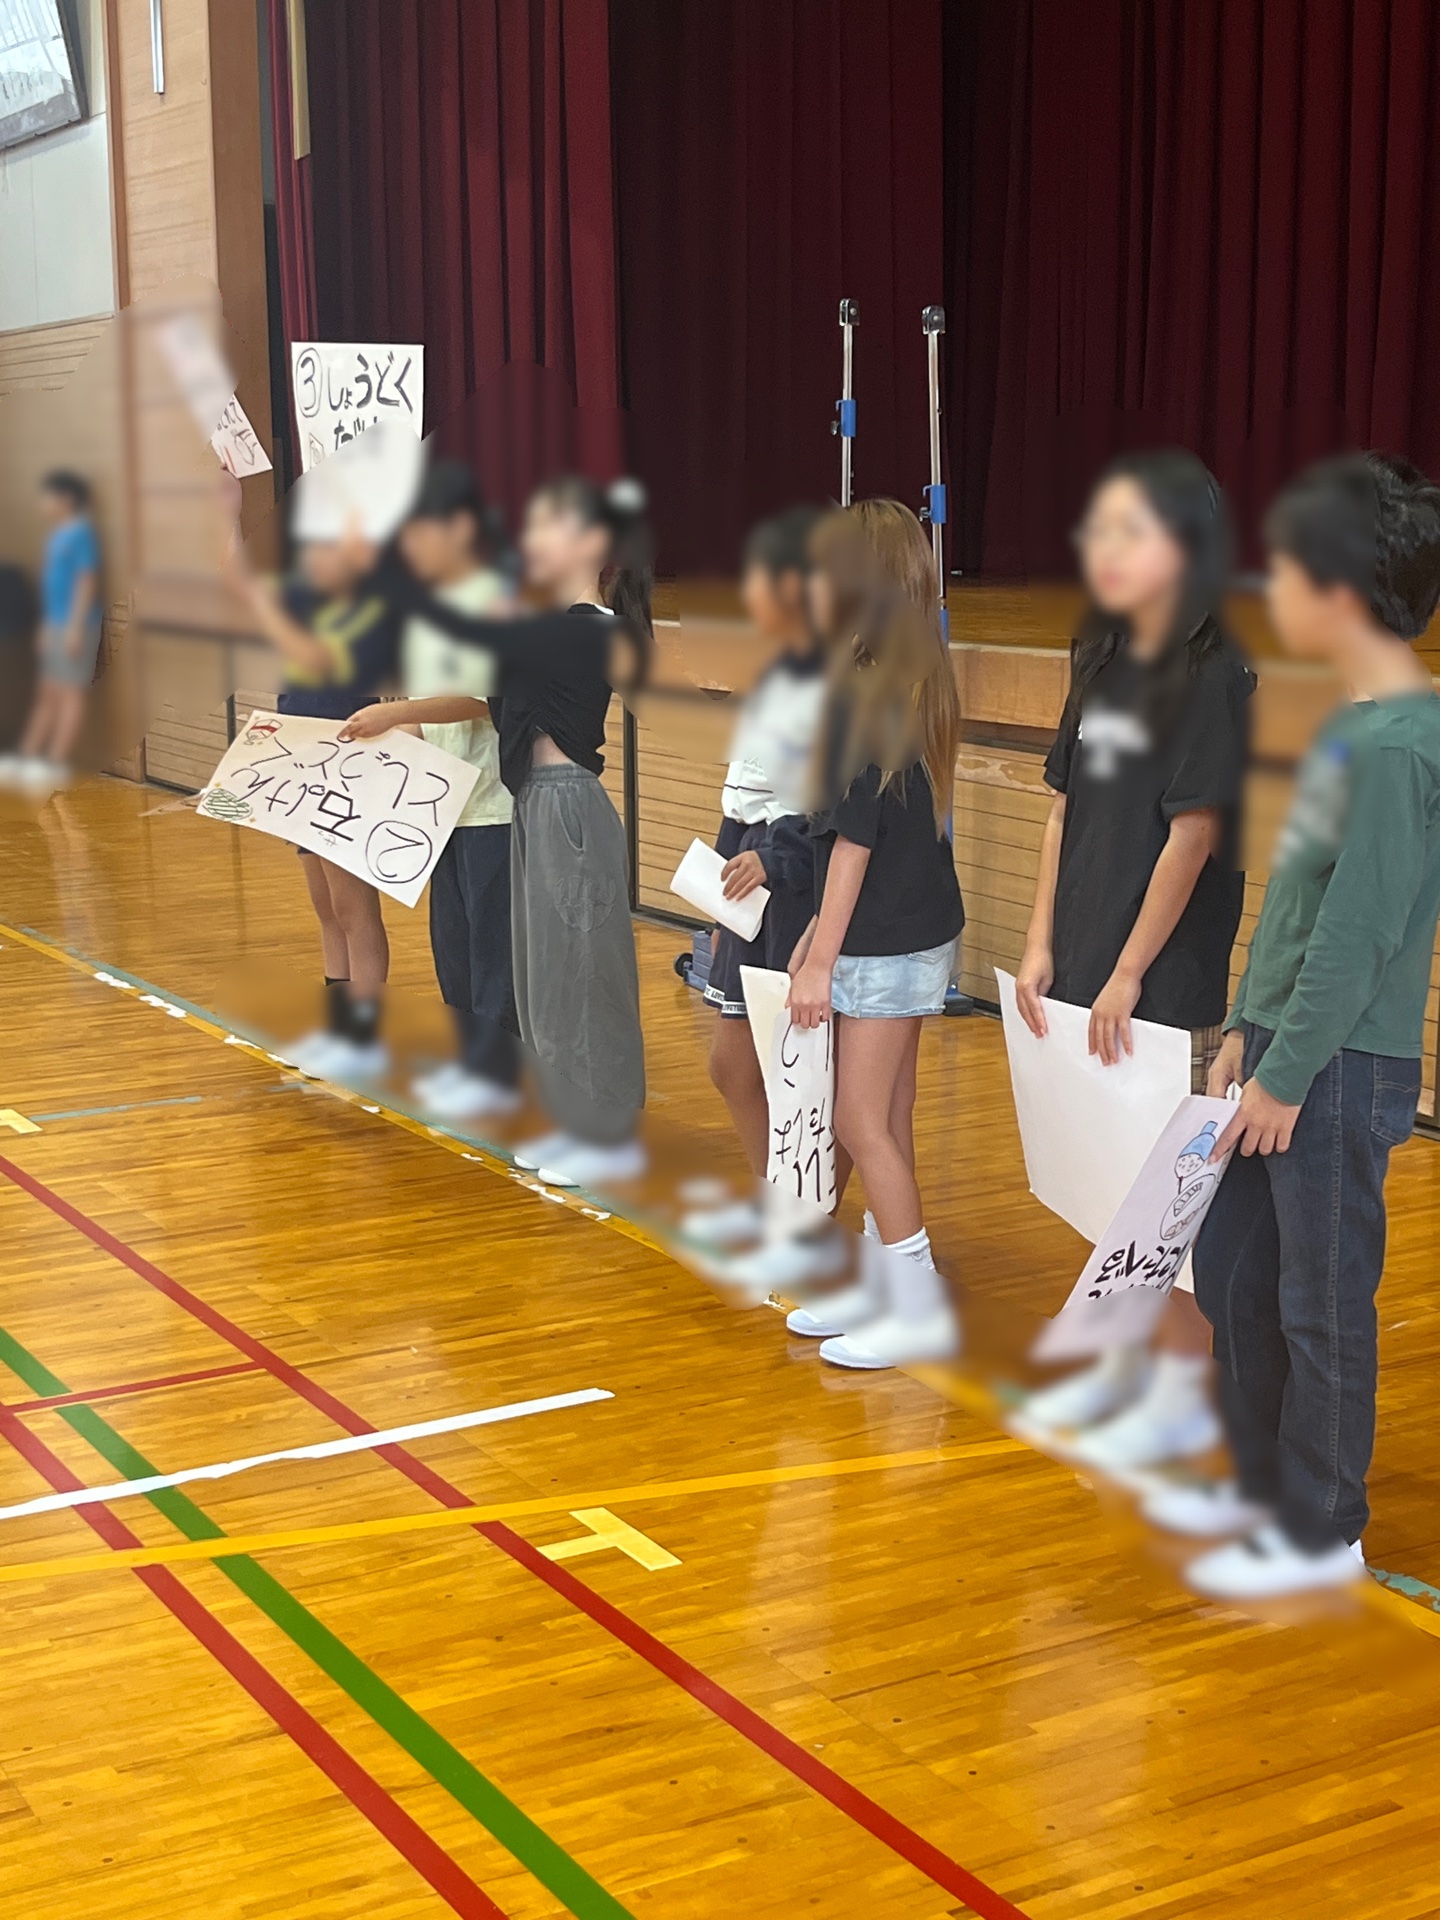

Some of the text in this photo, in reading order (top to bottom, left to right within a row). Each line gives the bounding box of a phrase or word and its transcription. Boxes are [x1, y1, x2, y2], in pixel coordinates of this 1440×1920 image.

[249, 736, 450, 827] としょうどく
